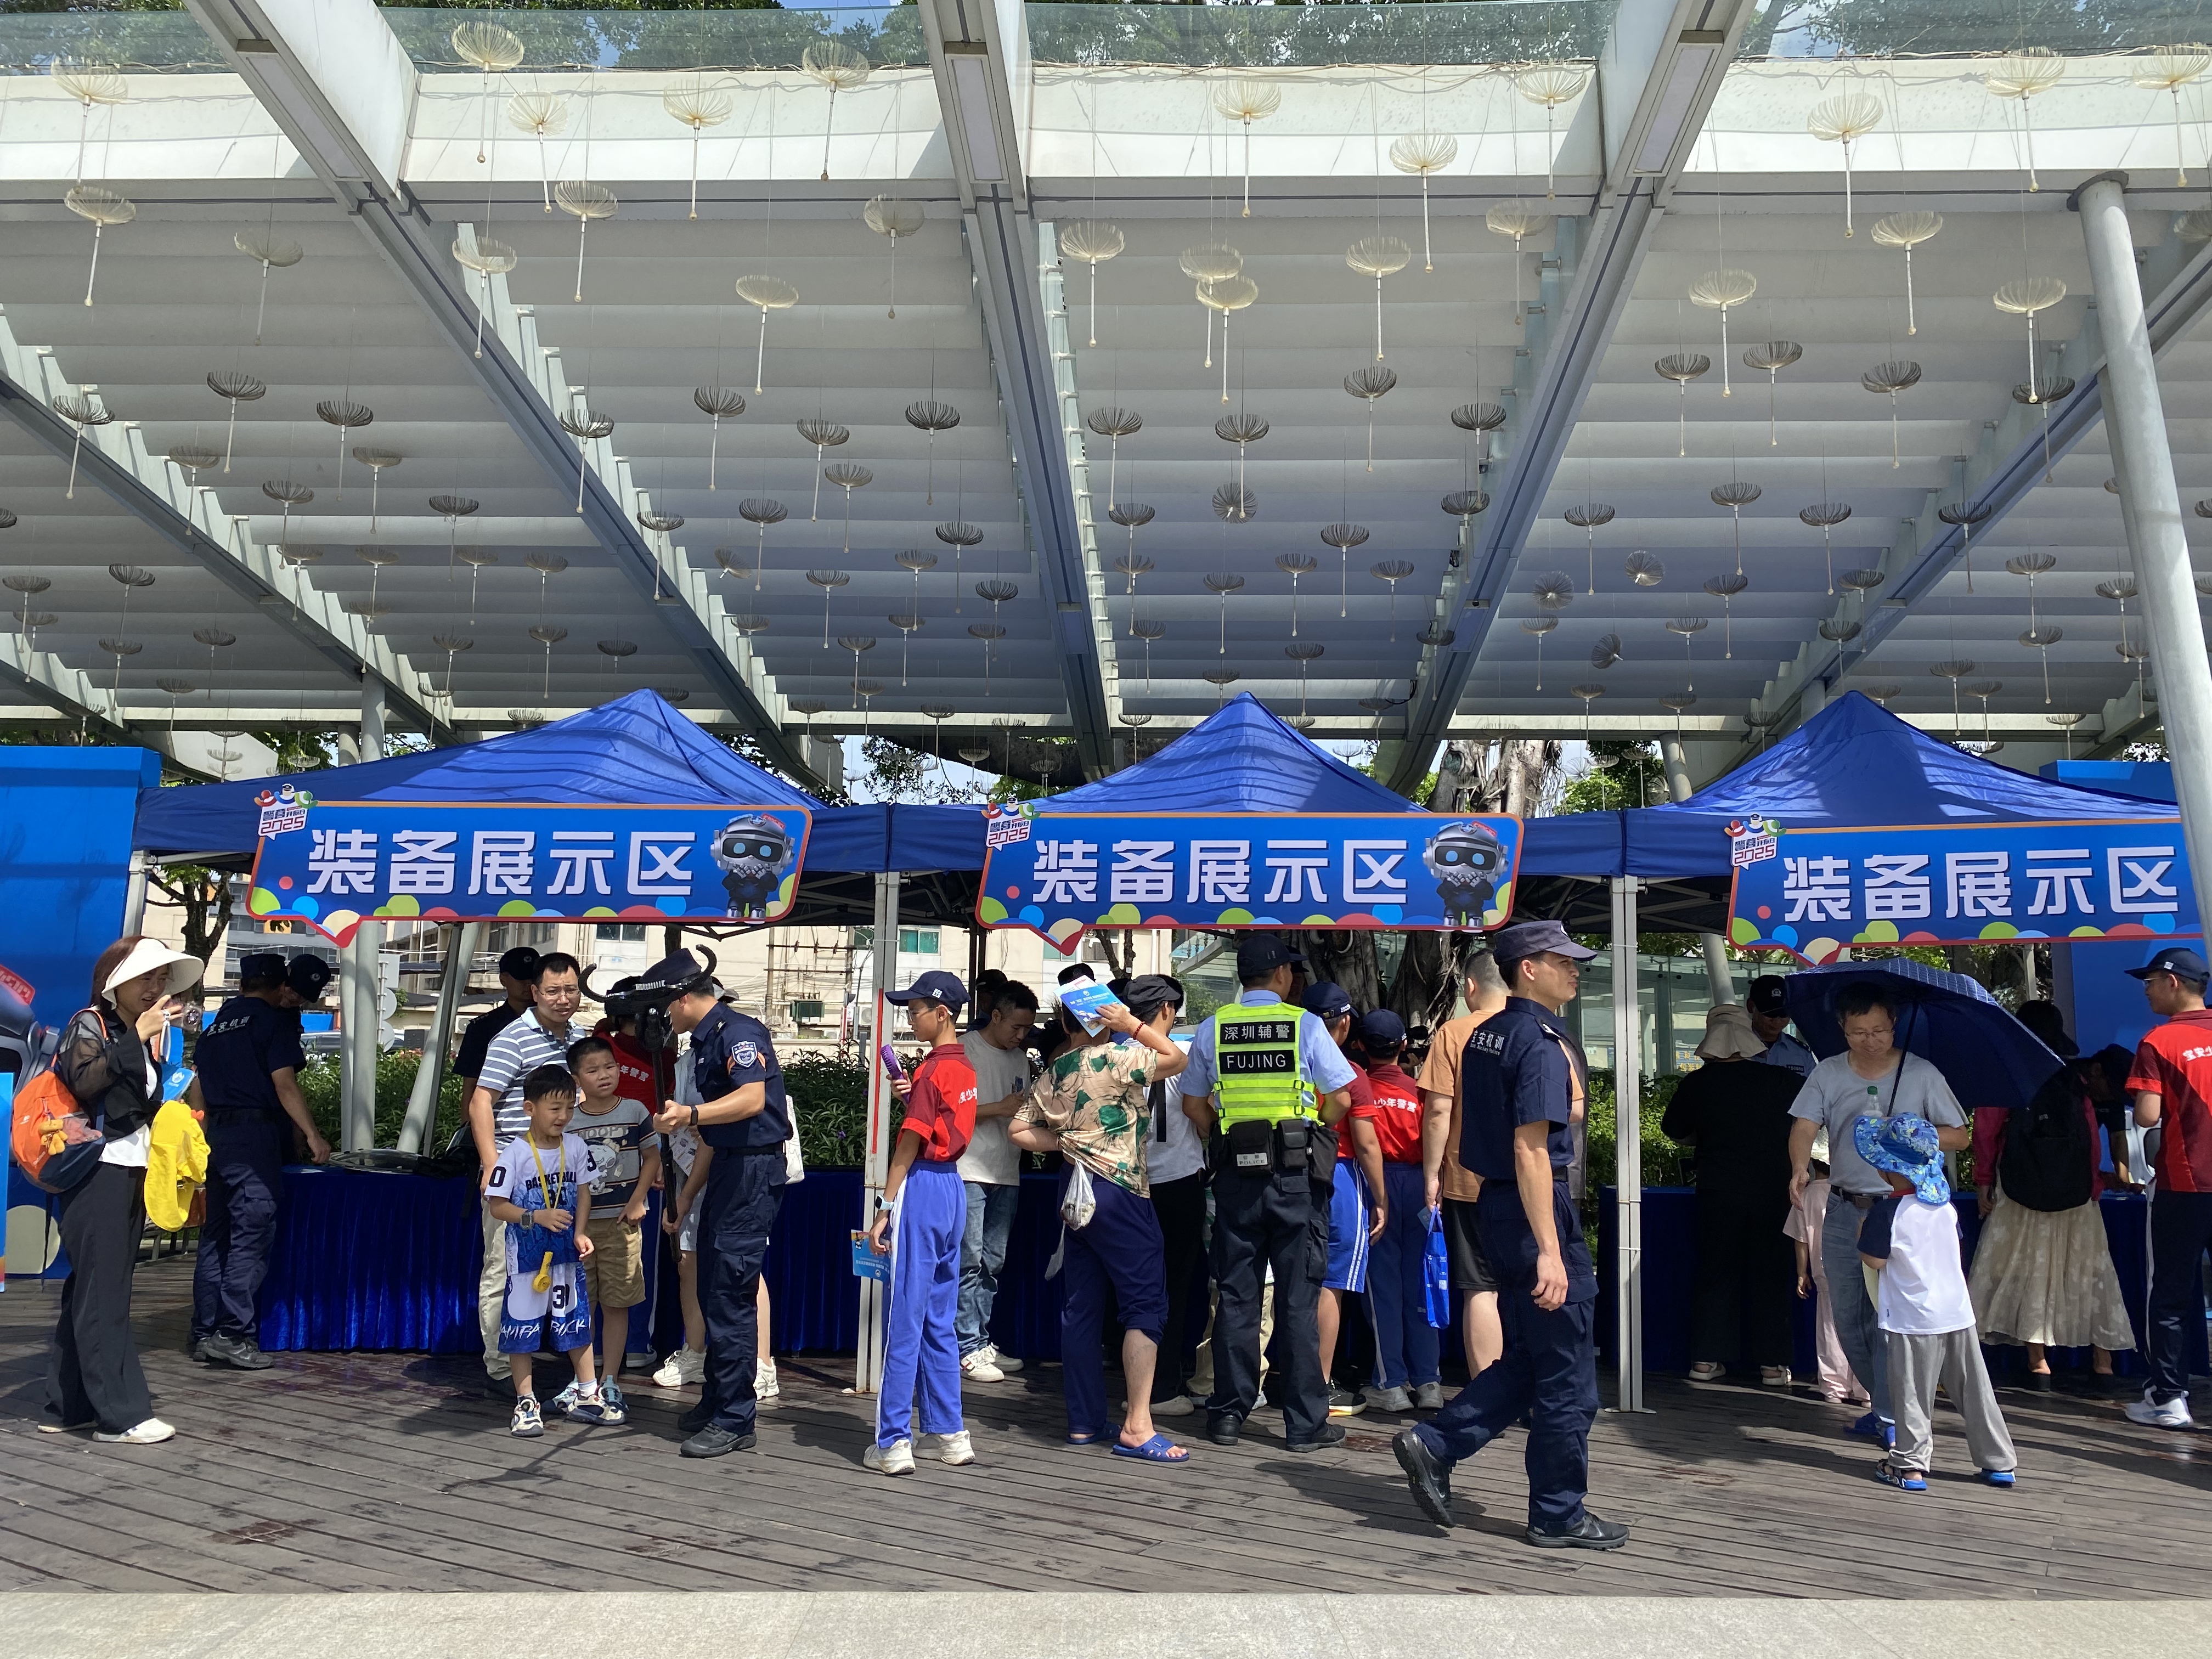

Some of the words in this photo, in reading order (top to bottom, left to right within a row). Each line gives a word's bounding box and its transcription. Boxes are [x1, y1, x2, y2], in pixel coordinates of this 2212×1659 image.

[261, 816, 304, 833] 2025
[989, 827, 1028, 845] 2025
[307, 829, 696, 895] 装备展示区
[1735, 844, 1774, 864] 2025
[1032, 839, 1407, 903] 装备展示区
[1784, 846, 2178, 922] 装备展示区
[1224, 1024, 1290, 1040] 深圳辅警
[1227, 1054, 1286, 1069] FUJING
[1374, 1098, 1417, 1113] 少年警营
[578, 1126, 629, 1140] NOOPY
